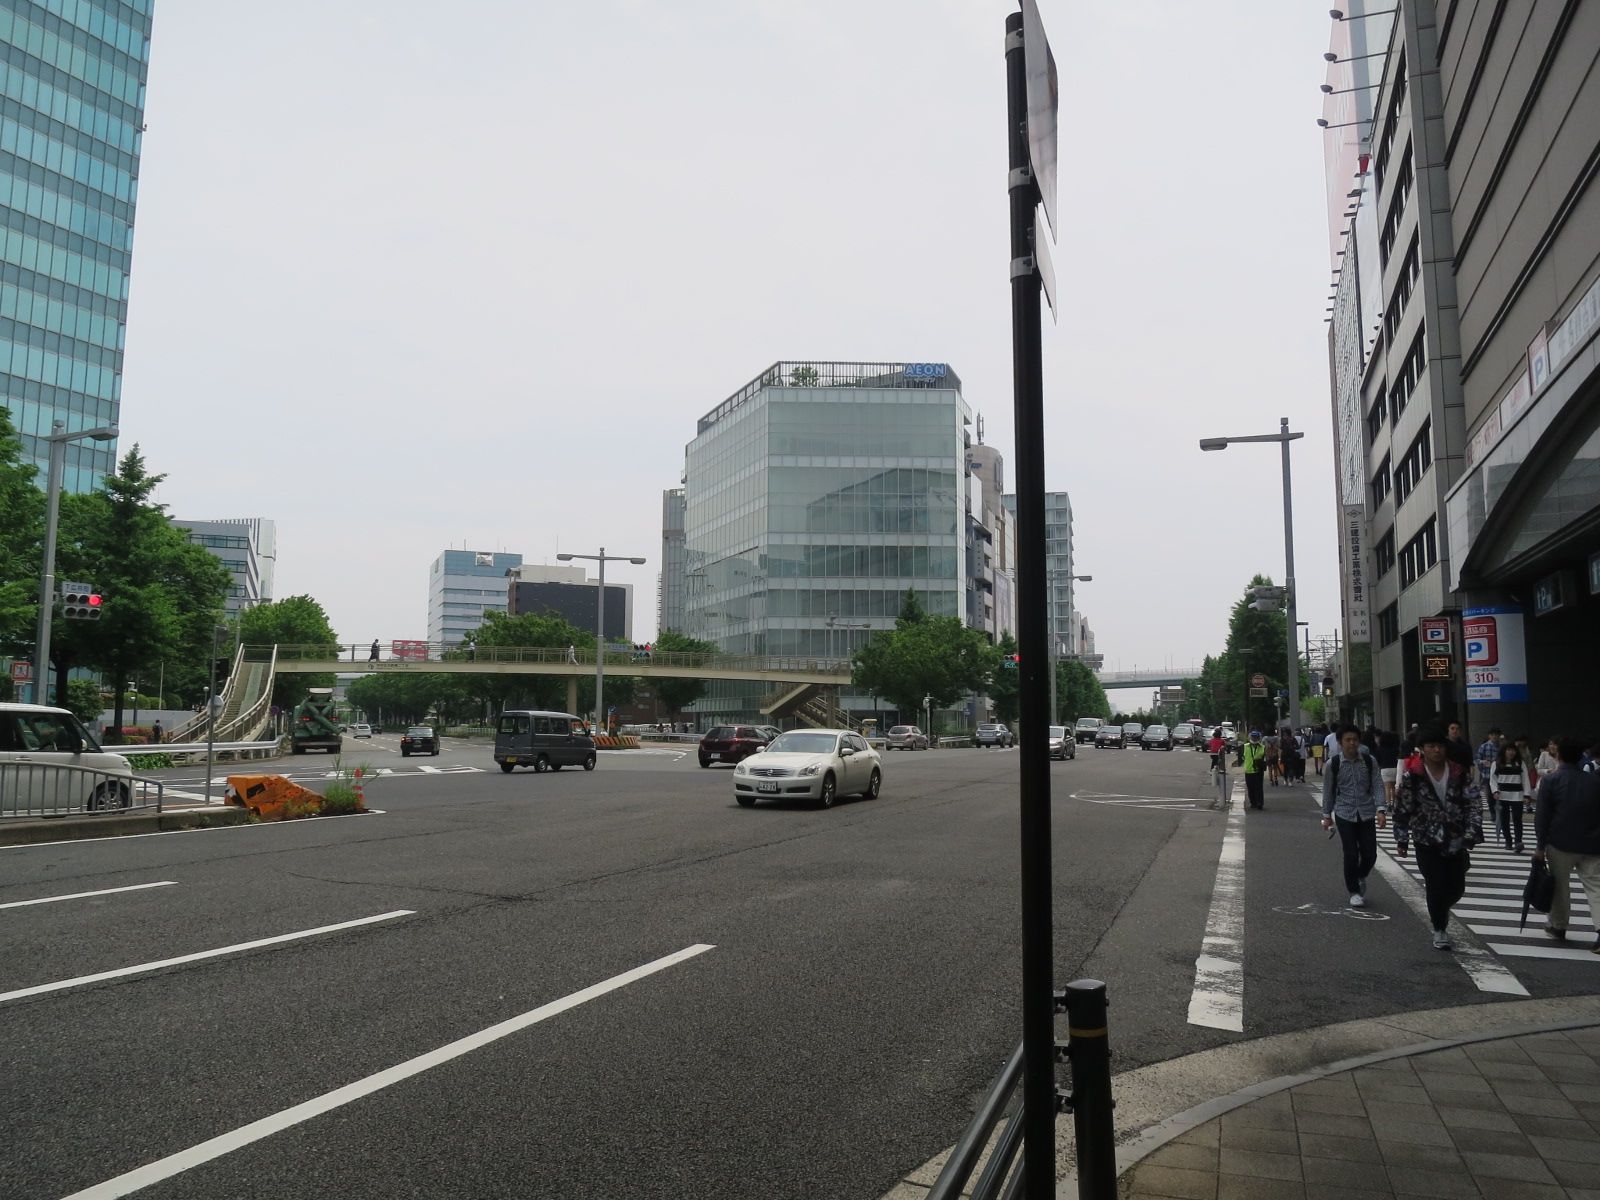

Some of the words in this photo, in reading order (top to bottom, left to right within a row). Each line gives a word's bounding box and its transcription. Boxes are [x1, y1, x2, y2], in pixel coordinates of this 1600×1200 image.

[905, 363, 945, 376] AEON
[1430, 630, 1441, 640] P
[1467, 641, 1483, 659] P
